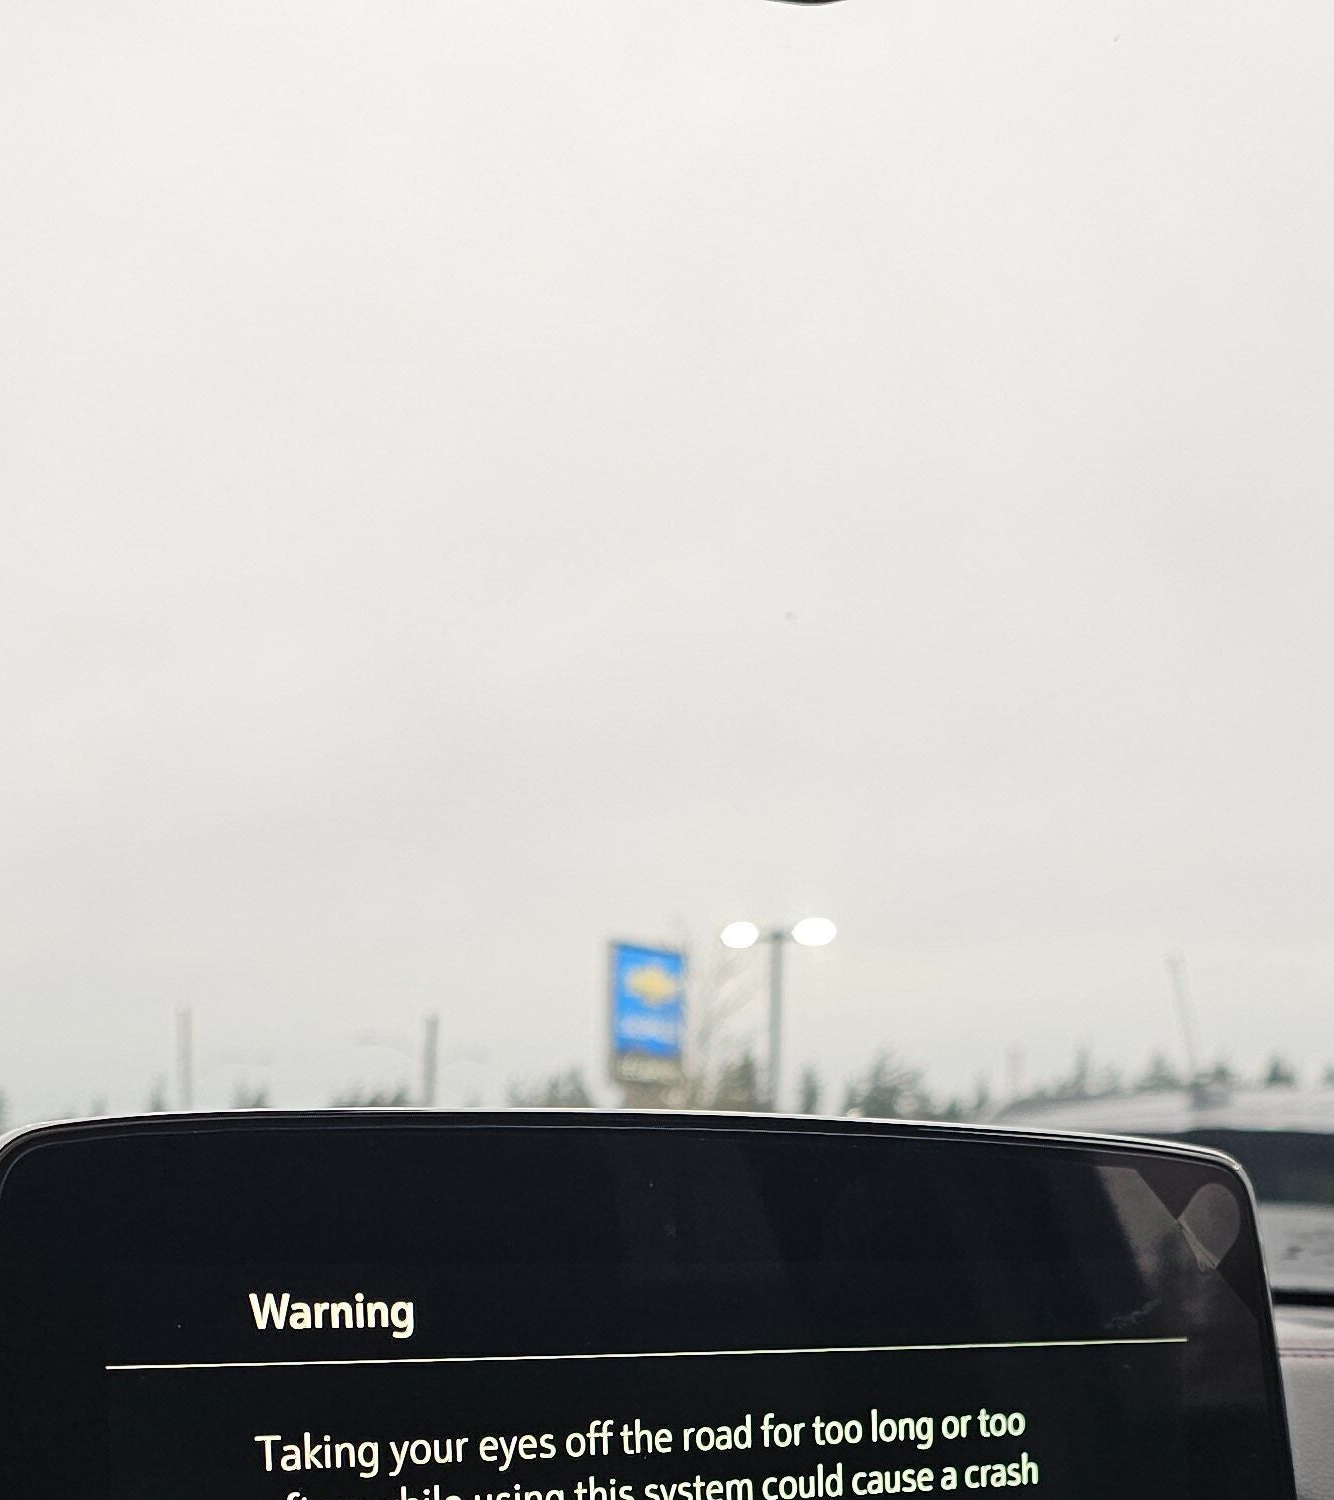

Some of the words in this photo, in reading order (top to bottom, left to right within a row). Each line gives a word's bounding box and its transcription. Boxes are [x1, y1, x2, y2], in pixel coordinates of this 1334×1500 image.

[249, 1293, 415, 1338] Warning
[255, 1432, 379, 1478] Taking
[389, 1438, 469, 1476] your
[480, 1434, 557, 1471] eyes
[566, 1420, 614, 1458] off
[622, 1419, 673, 1455] the
[683, 1414, 752, 1451] road
[761, 1413, 806, 1447] for
[812, 1415, 863, 1445] too
[871, 1409, 934, 1450] long
[941, 1415, 969, 1438] or
[979, 1409, 1026, 1436] too
[762, 1462, 844, 1500] could
[852, 1467, 934, 1496] cause
[941, 1466, 958, 1490] a
[965, 1452, 1039, 1489] crash
